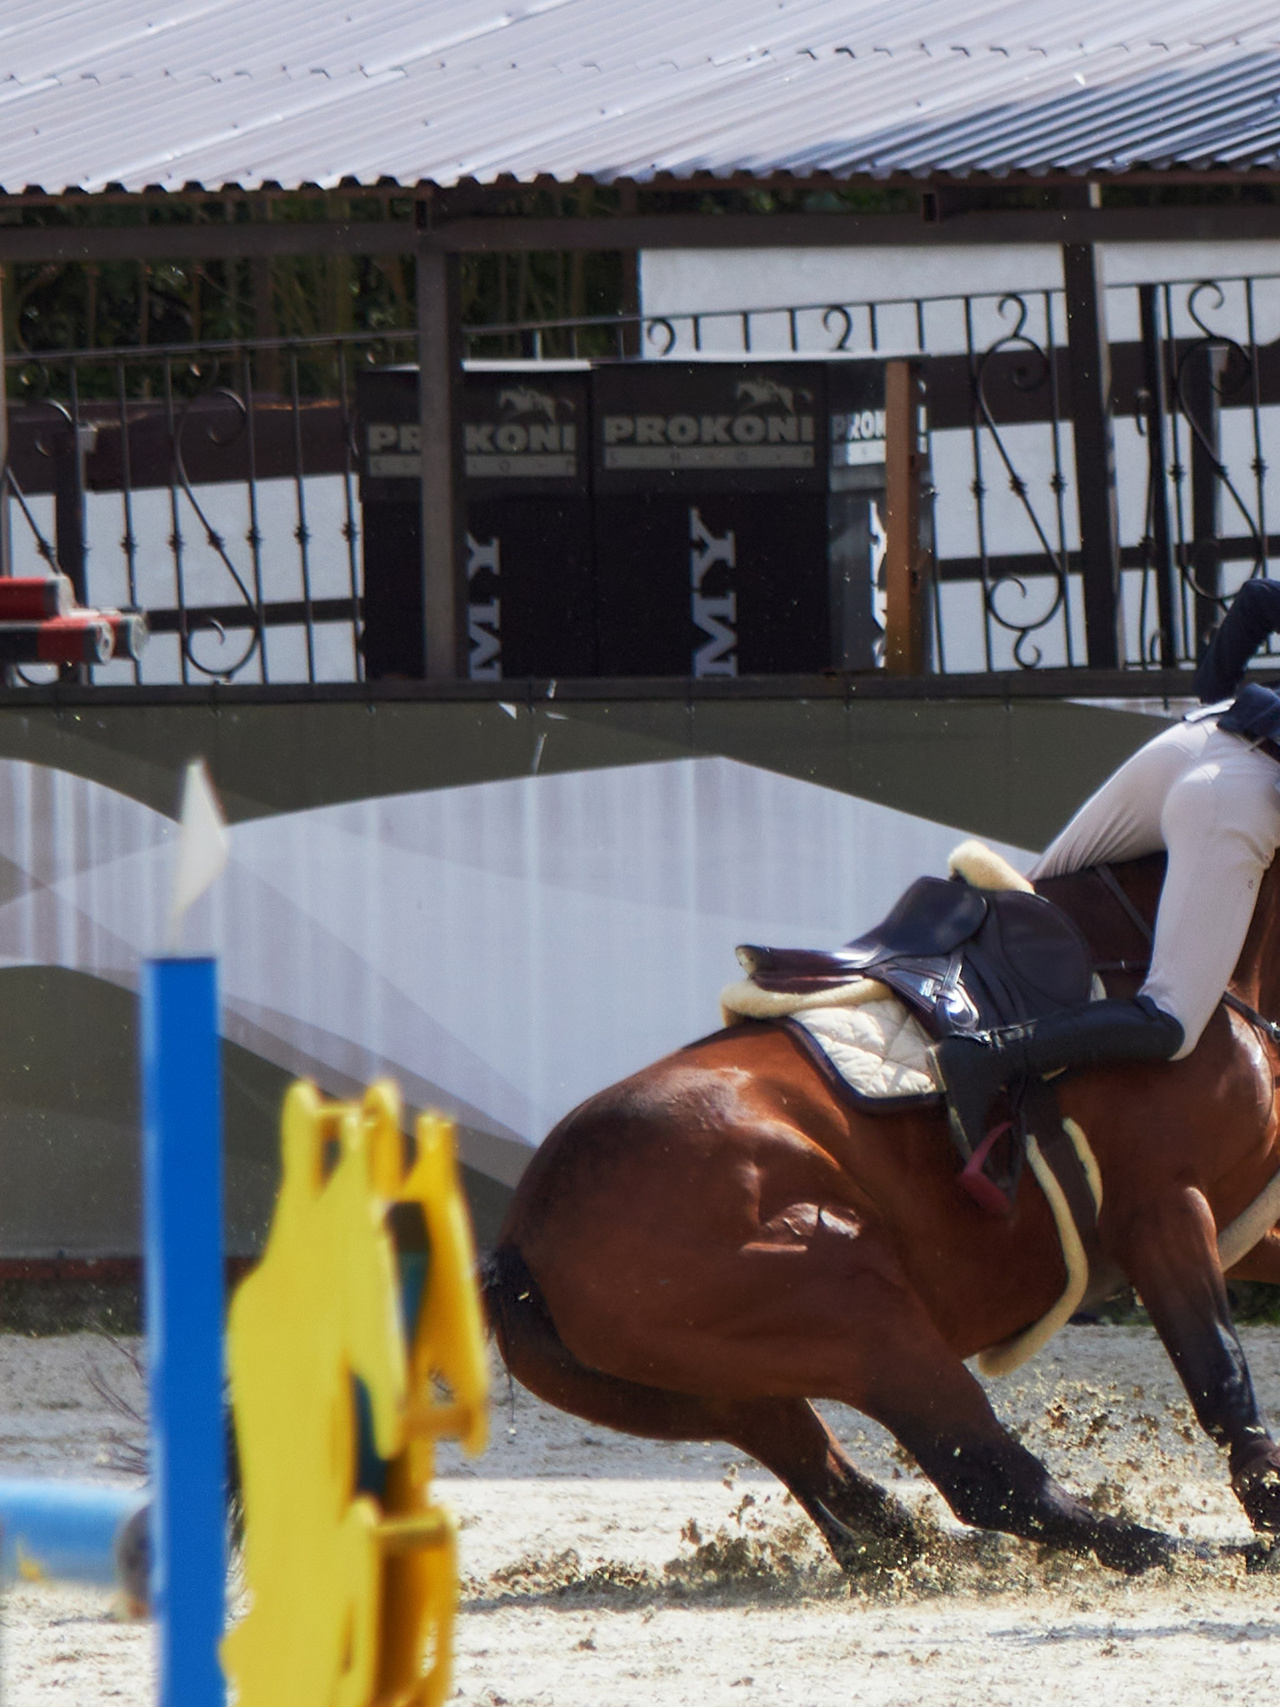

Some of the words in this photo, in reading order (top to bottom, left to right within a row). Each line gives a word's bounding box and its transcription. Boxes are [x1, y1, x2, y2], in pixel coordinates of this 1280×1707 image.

[368, 424, 576, 452] PRKONI
[604, 415, 815, 444] PROKONI
[691, 506, 737, 679] MY
